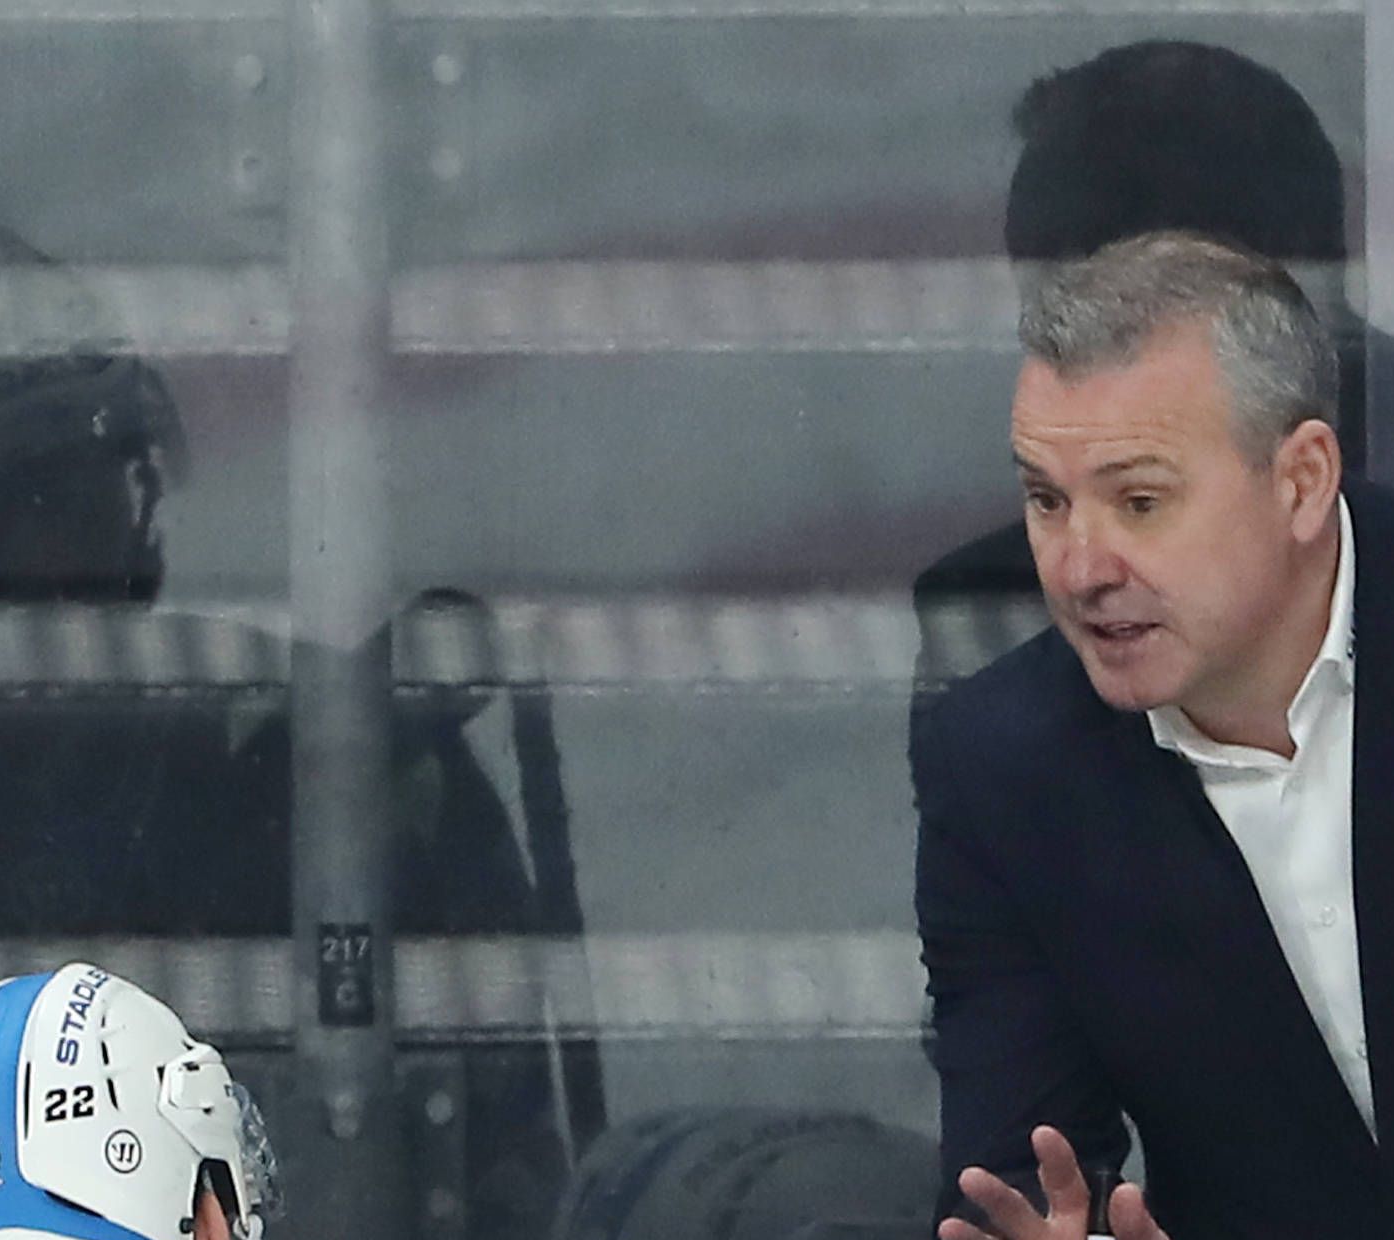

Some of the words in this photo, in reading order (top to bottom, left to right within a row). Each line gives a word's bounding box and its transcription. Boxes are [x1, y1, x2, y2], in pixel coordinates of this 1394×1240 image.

[323, 936, 369, 962] 217
[56, 967, 111, 1066] STADLE
[44, 1085, 95, 1122] 22
